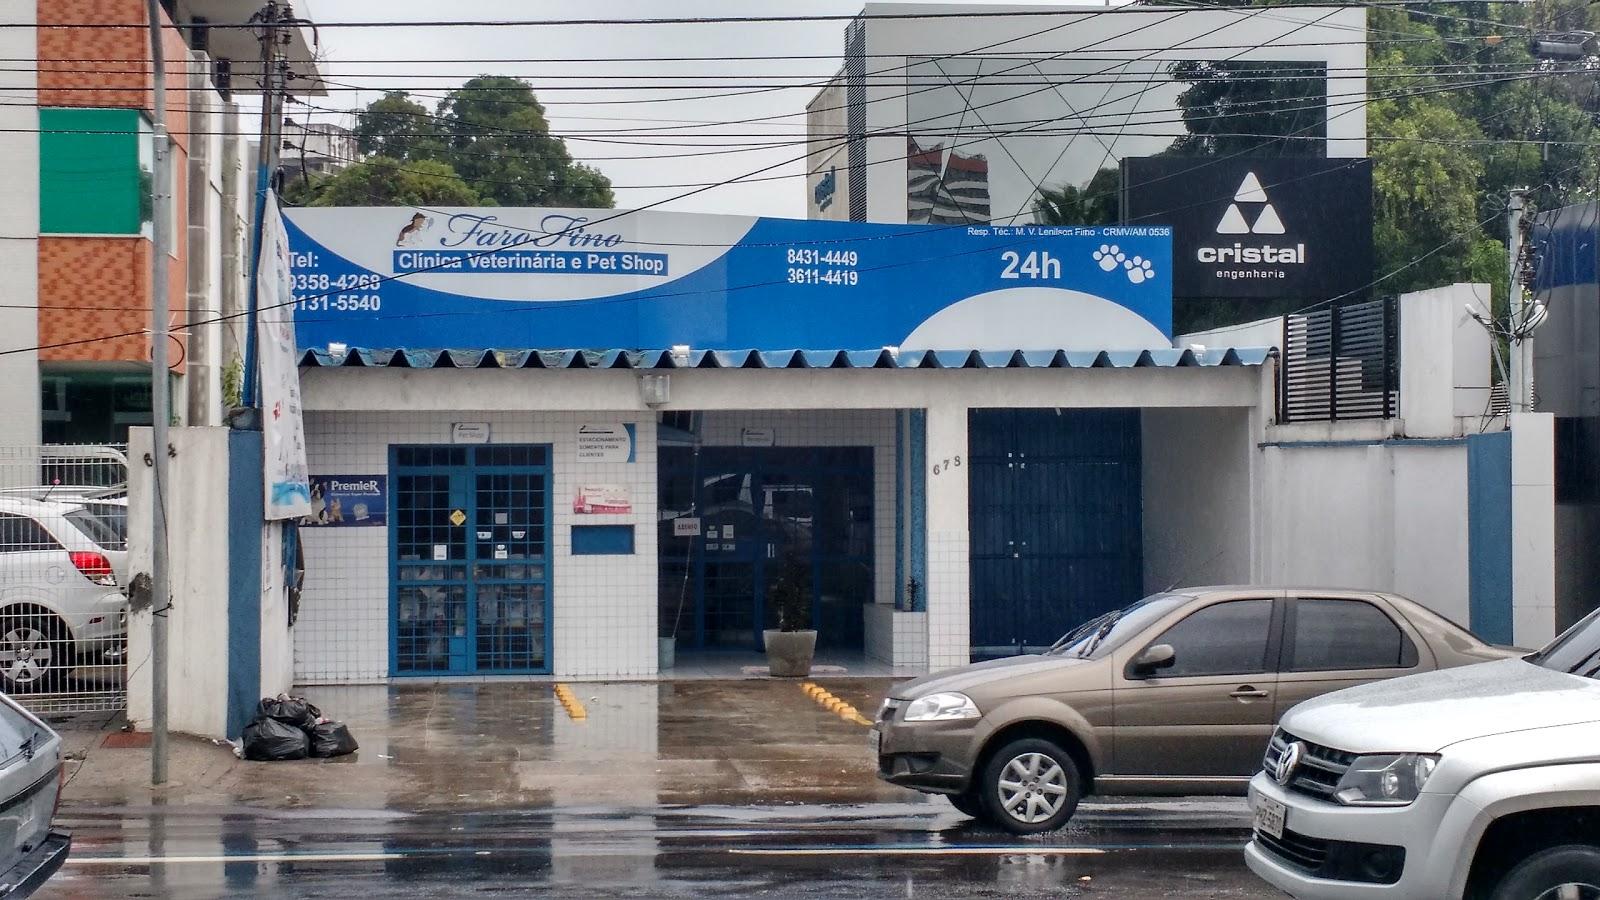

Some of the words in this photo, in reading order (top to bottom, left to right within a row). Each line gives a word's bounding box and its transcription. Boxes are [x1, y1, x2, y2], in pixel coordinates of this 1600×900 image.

[1103, 227, 1147, 236] CRMV/AM
[289, 251, 319, 268] Tel:
[787, 248, 858, 266] 8431-4449
[1197, 242, 1305, 264] cristal
[399, 252, 463, 269] Clínica
[467, 252, 566, 269] Veterinária
[571, 257, 582, 269] e
[587, 253, 617, 270] Pet
[621, 254, 664, 274] Shop
[1000, 251, 1061, 279] 24h
[787, 267, 858, 286] 3611-4419
[1216, 269, 1285, 280] engenharia
[933, 455, 961, 476] 678
